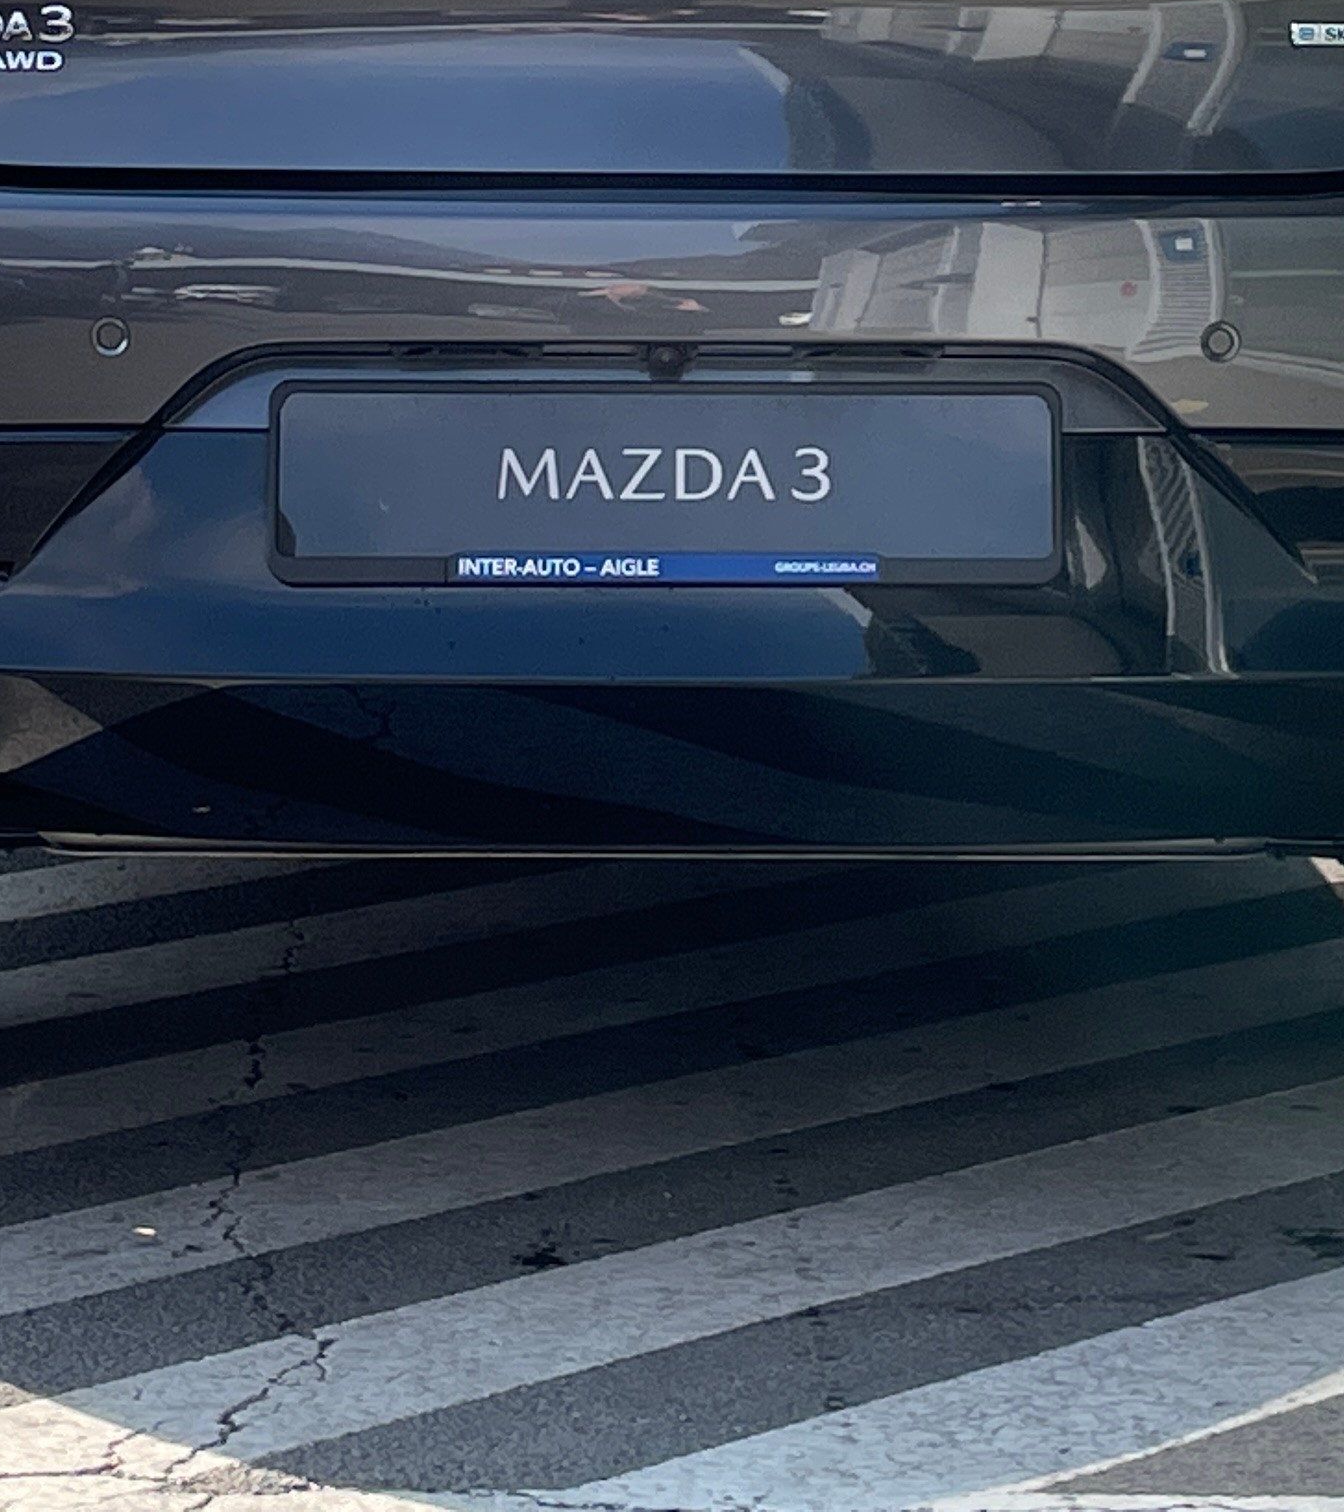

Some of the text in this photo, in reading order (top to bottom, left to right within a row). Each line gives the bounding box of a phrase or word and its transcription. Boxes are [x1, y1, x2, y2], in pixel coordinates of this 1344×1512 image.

[38, 4, 74, 43] 3
[497, 447, 833, 502] MAZDA 3
[458, 557, 581, 576] INTER-AUTO
[599, 557, 660, 576] AIGLE
